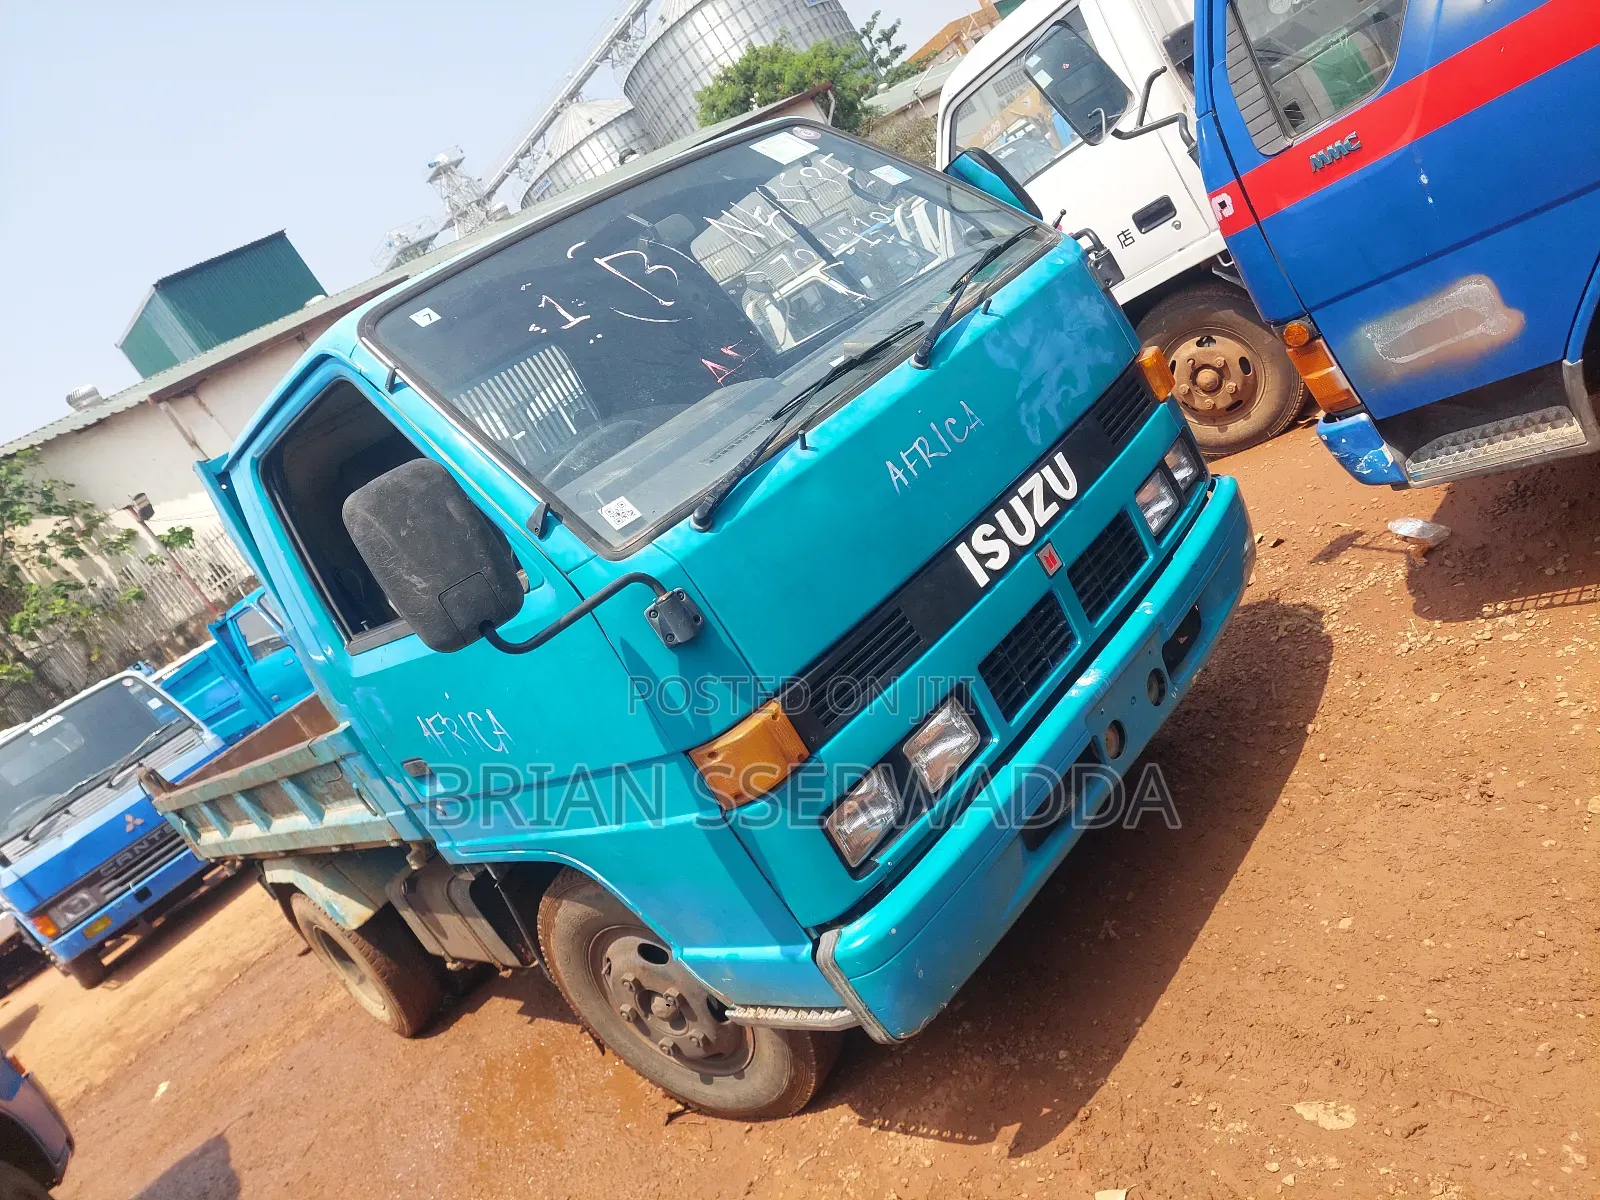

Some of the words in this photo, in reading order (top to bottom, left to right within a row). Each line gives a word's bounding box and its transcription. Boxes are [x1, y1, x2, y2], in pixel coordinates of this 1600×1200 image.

[1309, 131, 1362, 173] MMC
[1116, 228, 1136, 250] 店
[885, 400, 985, 496] AFRICA
[955, 451, 1078, 588] ISUZU
[416, 708, 516, 758] AFRICA
[101, 825, 173, 877] CANTE
